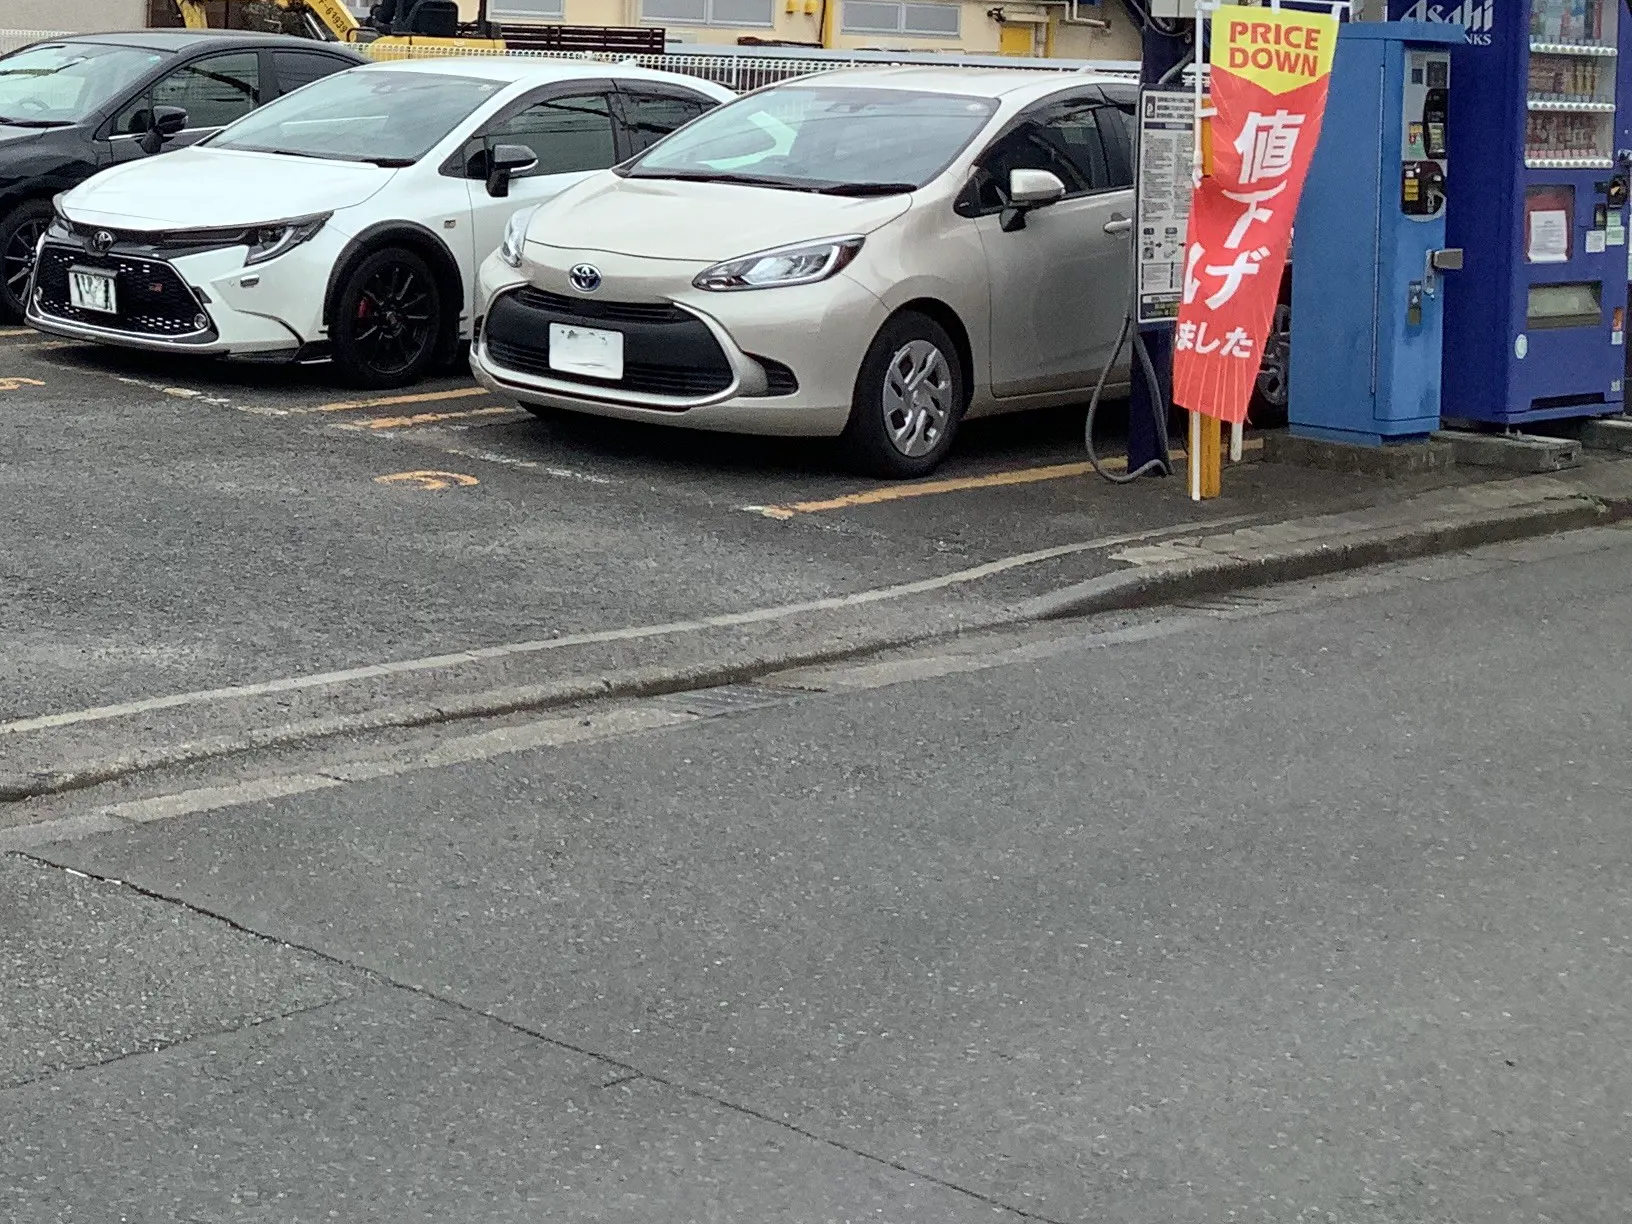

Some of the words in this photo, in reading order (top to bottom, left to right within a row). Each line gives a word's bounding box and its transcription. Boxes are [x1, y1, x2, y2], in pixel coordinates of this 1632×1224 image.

[1229, 21, 1321, 51] PRICE
[1229, 46, 1318, 77] DOWN
[1175, 319, 1254, 358] ました
